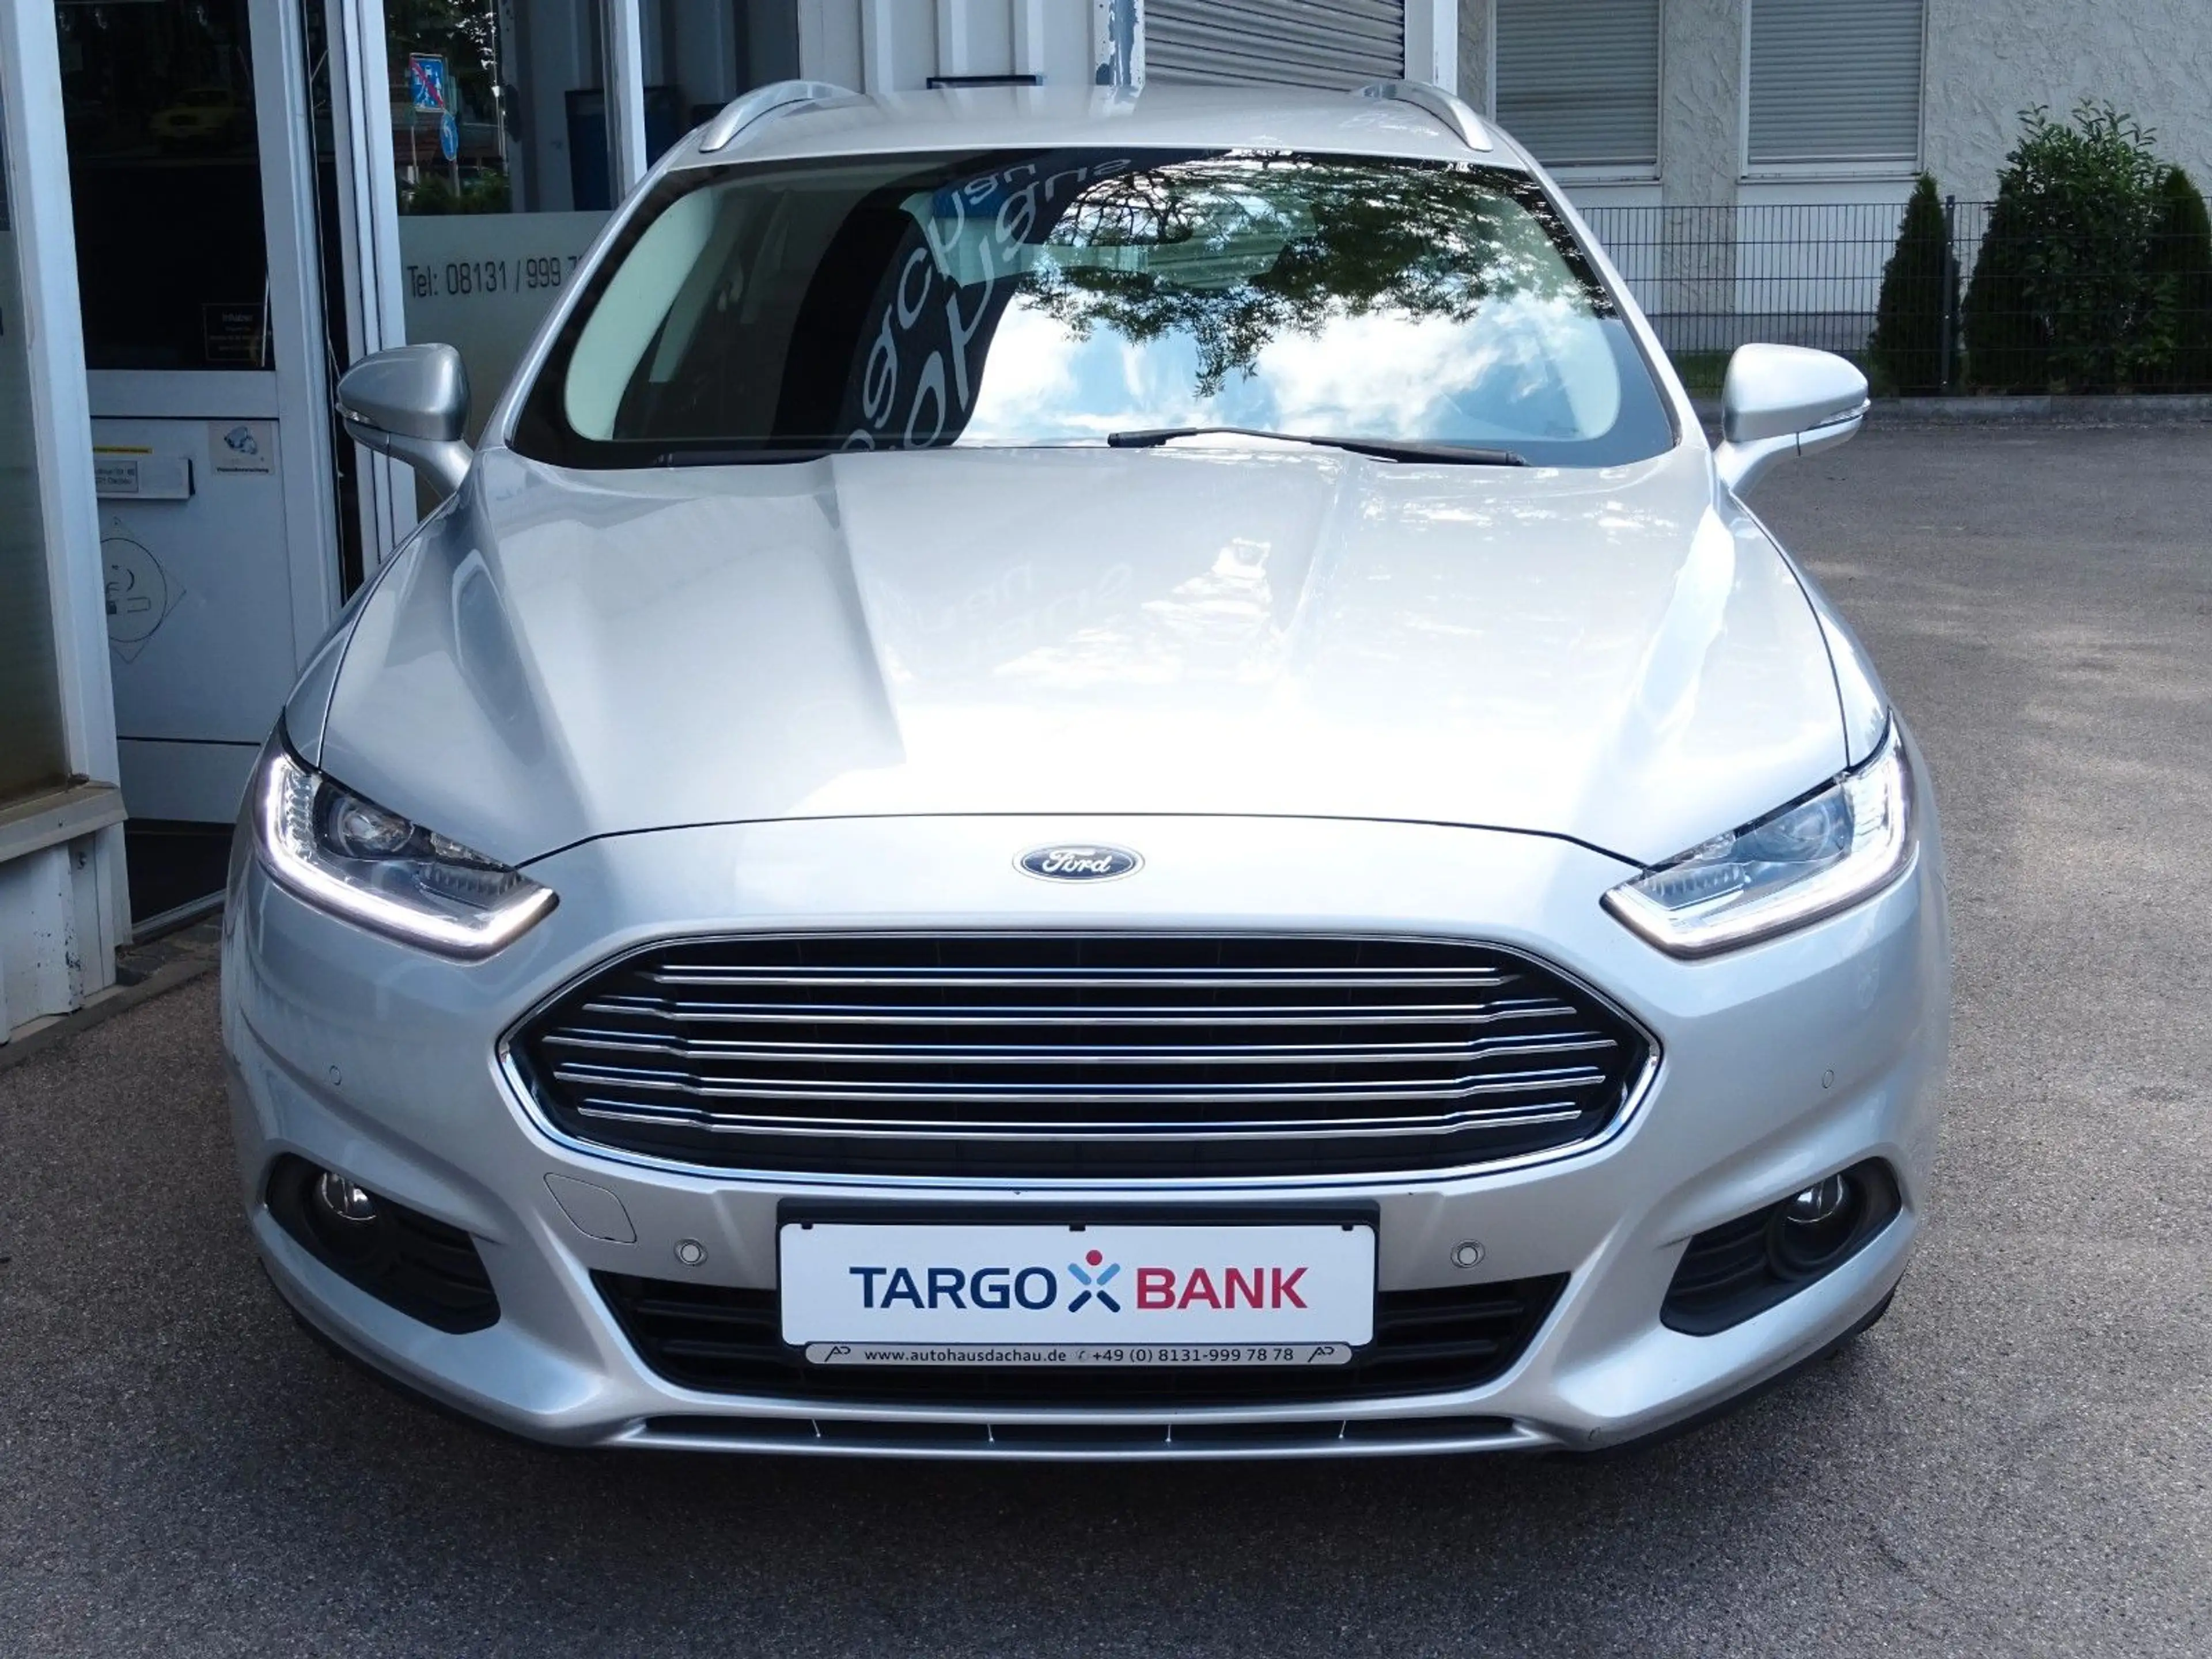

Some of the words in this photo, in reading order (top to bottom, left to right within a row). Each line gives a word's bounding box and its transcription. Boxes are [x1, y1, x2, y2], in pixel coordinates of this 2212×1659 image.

[407, 265, 438, 298] Tel:
[446, 261, 506, 295] 08131
[527, 257, 561, 287] 999
[1041, 849, 1113, 873] Ford
[849, 1267, 1058, 1309] TARGO
[1136, 1267, 1309, 1309] BANK
[864, 1349, 1067, 1362] www.autohausdachau.de
[1092, 1349, 1124, 1361] +49
[1129, 1349, 1153, 1363] (0)
[1158, 1349, 1241, 1362] 8131-999
[1247, 1349, 1268, 1362] 78
[1273, 1349, 1294, 1361] 78
